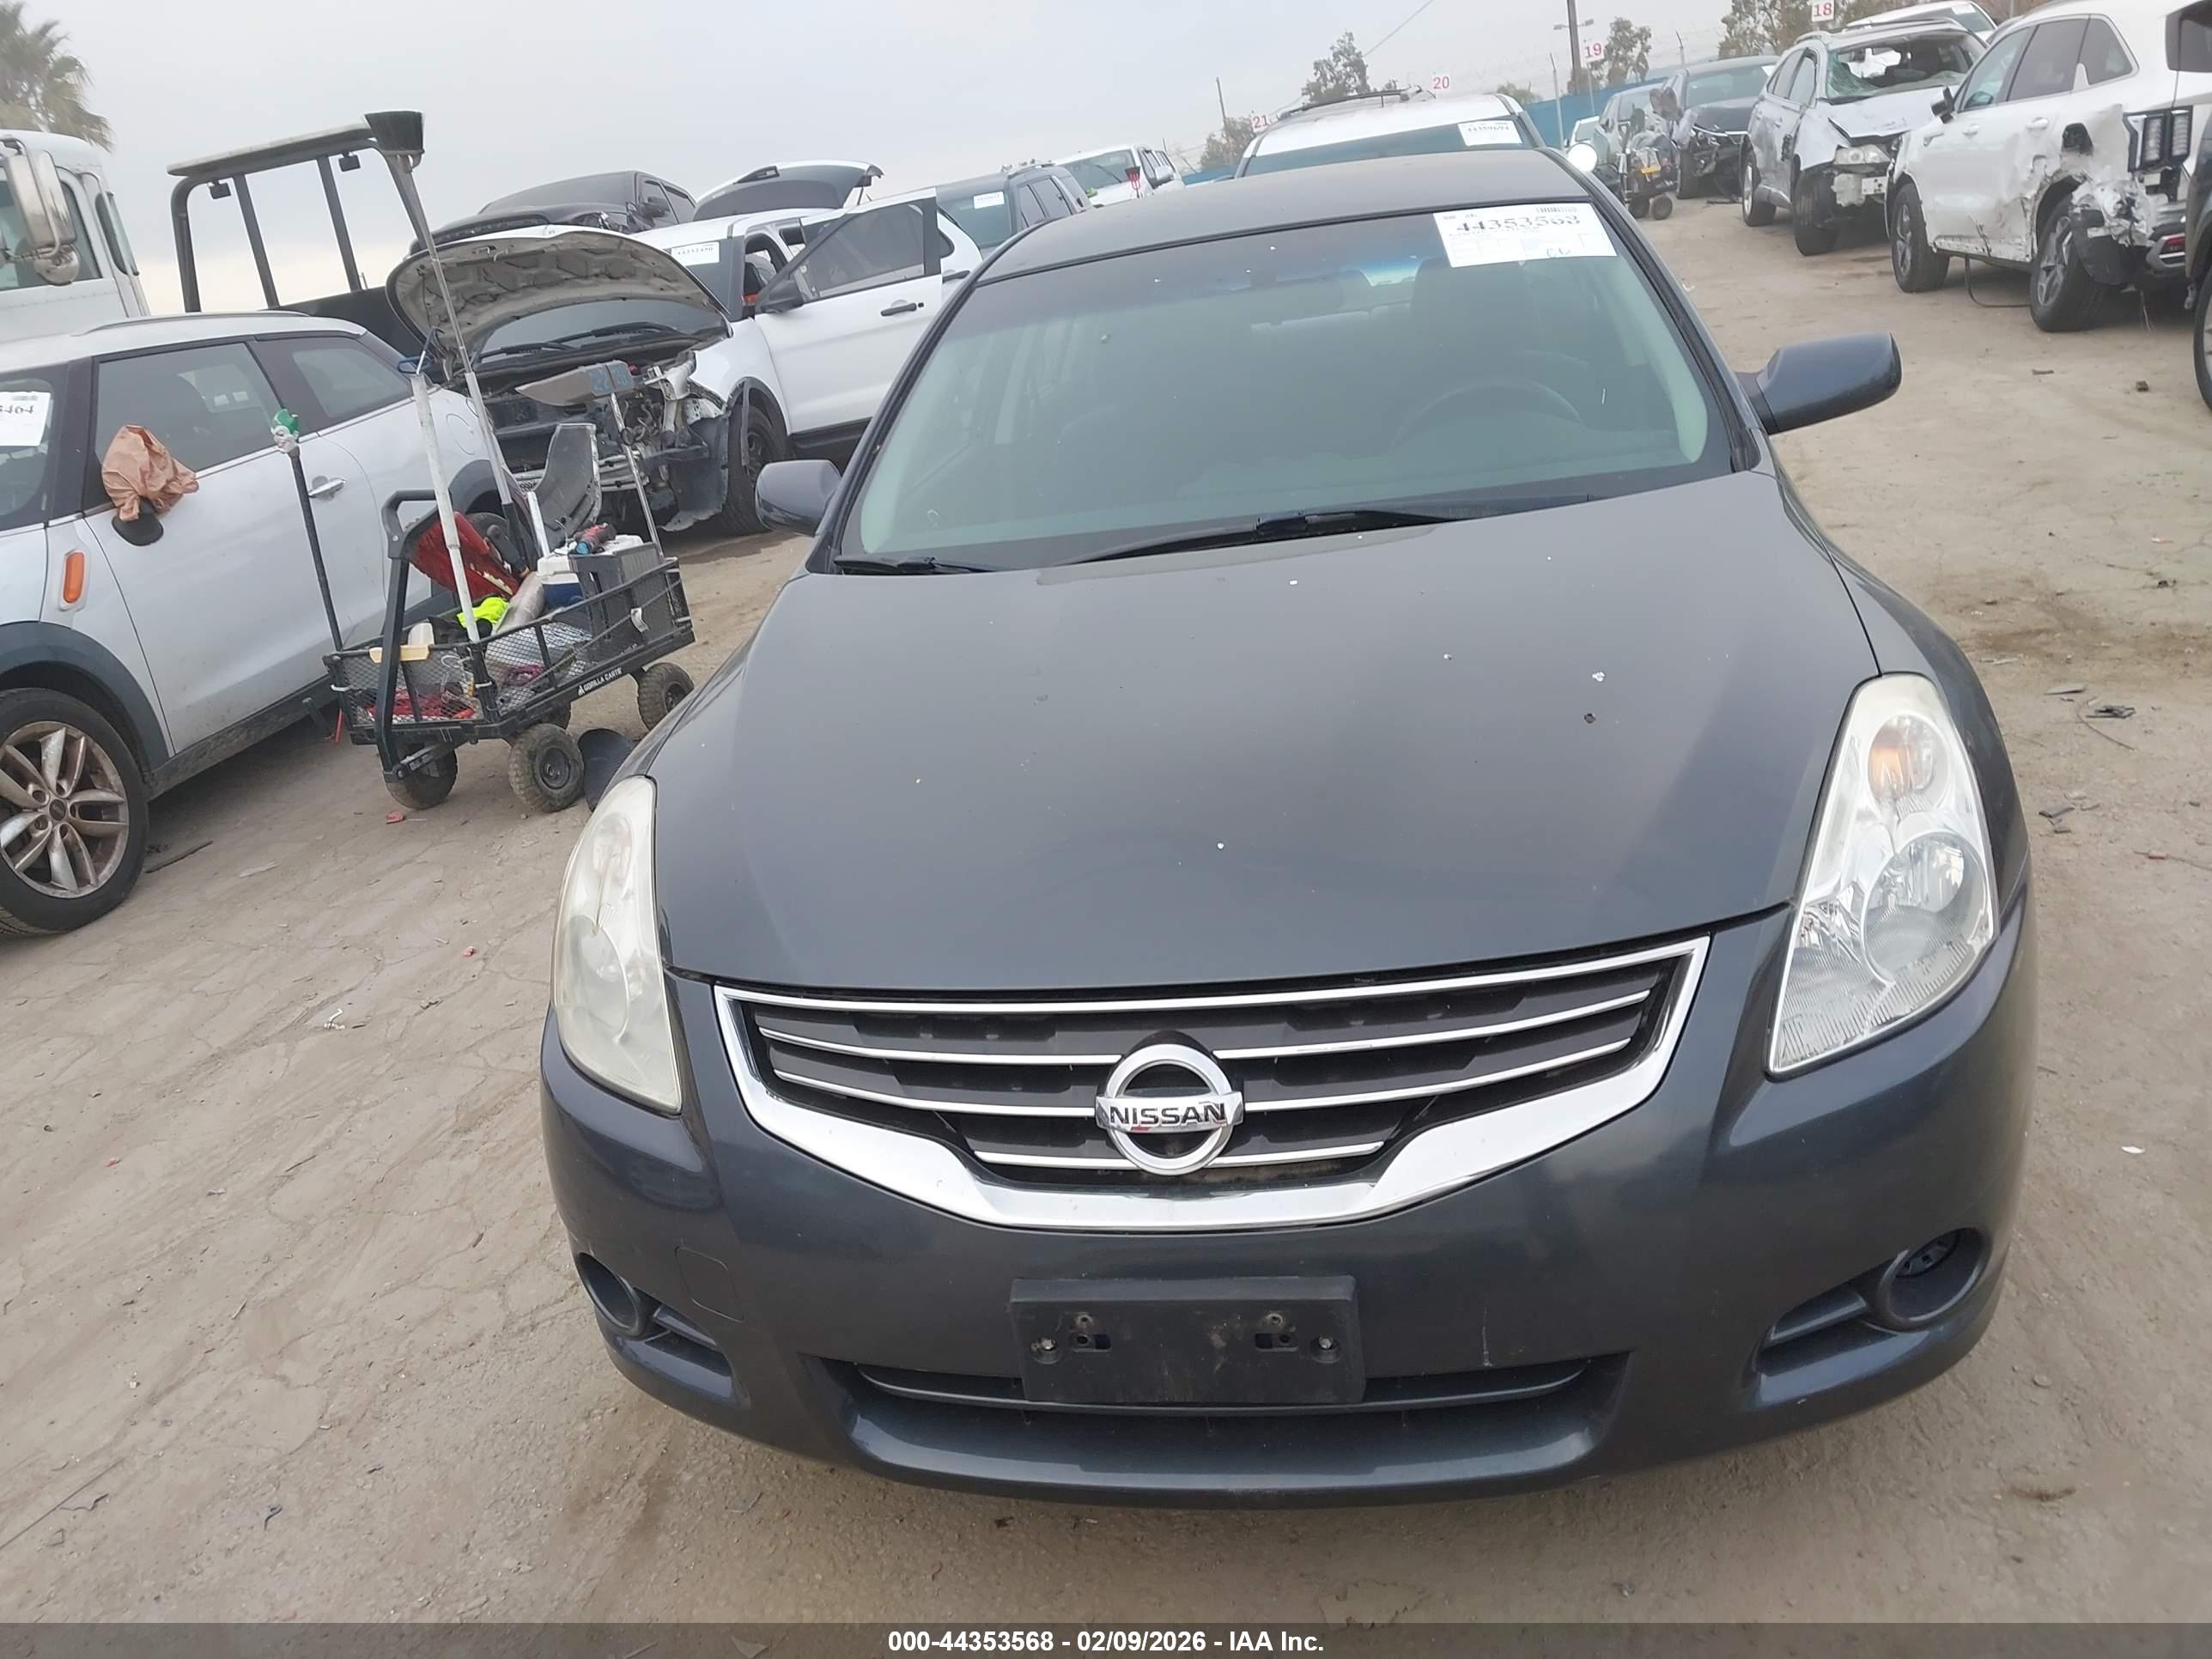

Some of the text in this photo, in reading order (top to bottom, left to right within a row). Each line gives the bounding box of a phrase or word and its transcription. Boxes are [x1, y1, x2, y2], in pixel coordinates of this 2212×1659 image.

[1813, 3, 1832, 17] 18
[1585, 43, 1601, 58] 19
[1433, 76, 1449, 89] 20
[1253, 115, 1267, 128] 21
[584, 675, 605, 691] GORILLA
[1110, 1103, 1226, 1125] NISSAN
